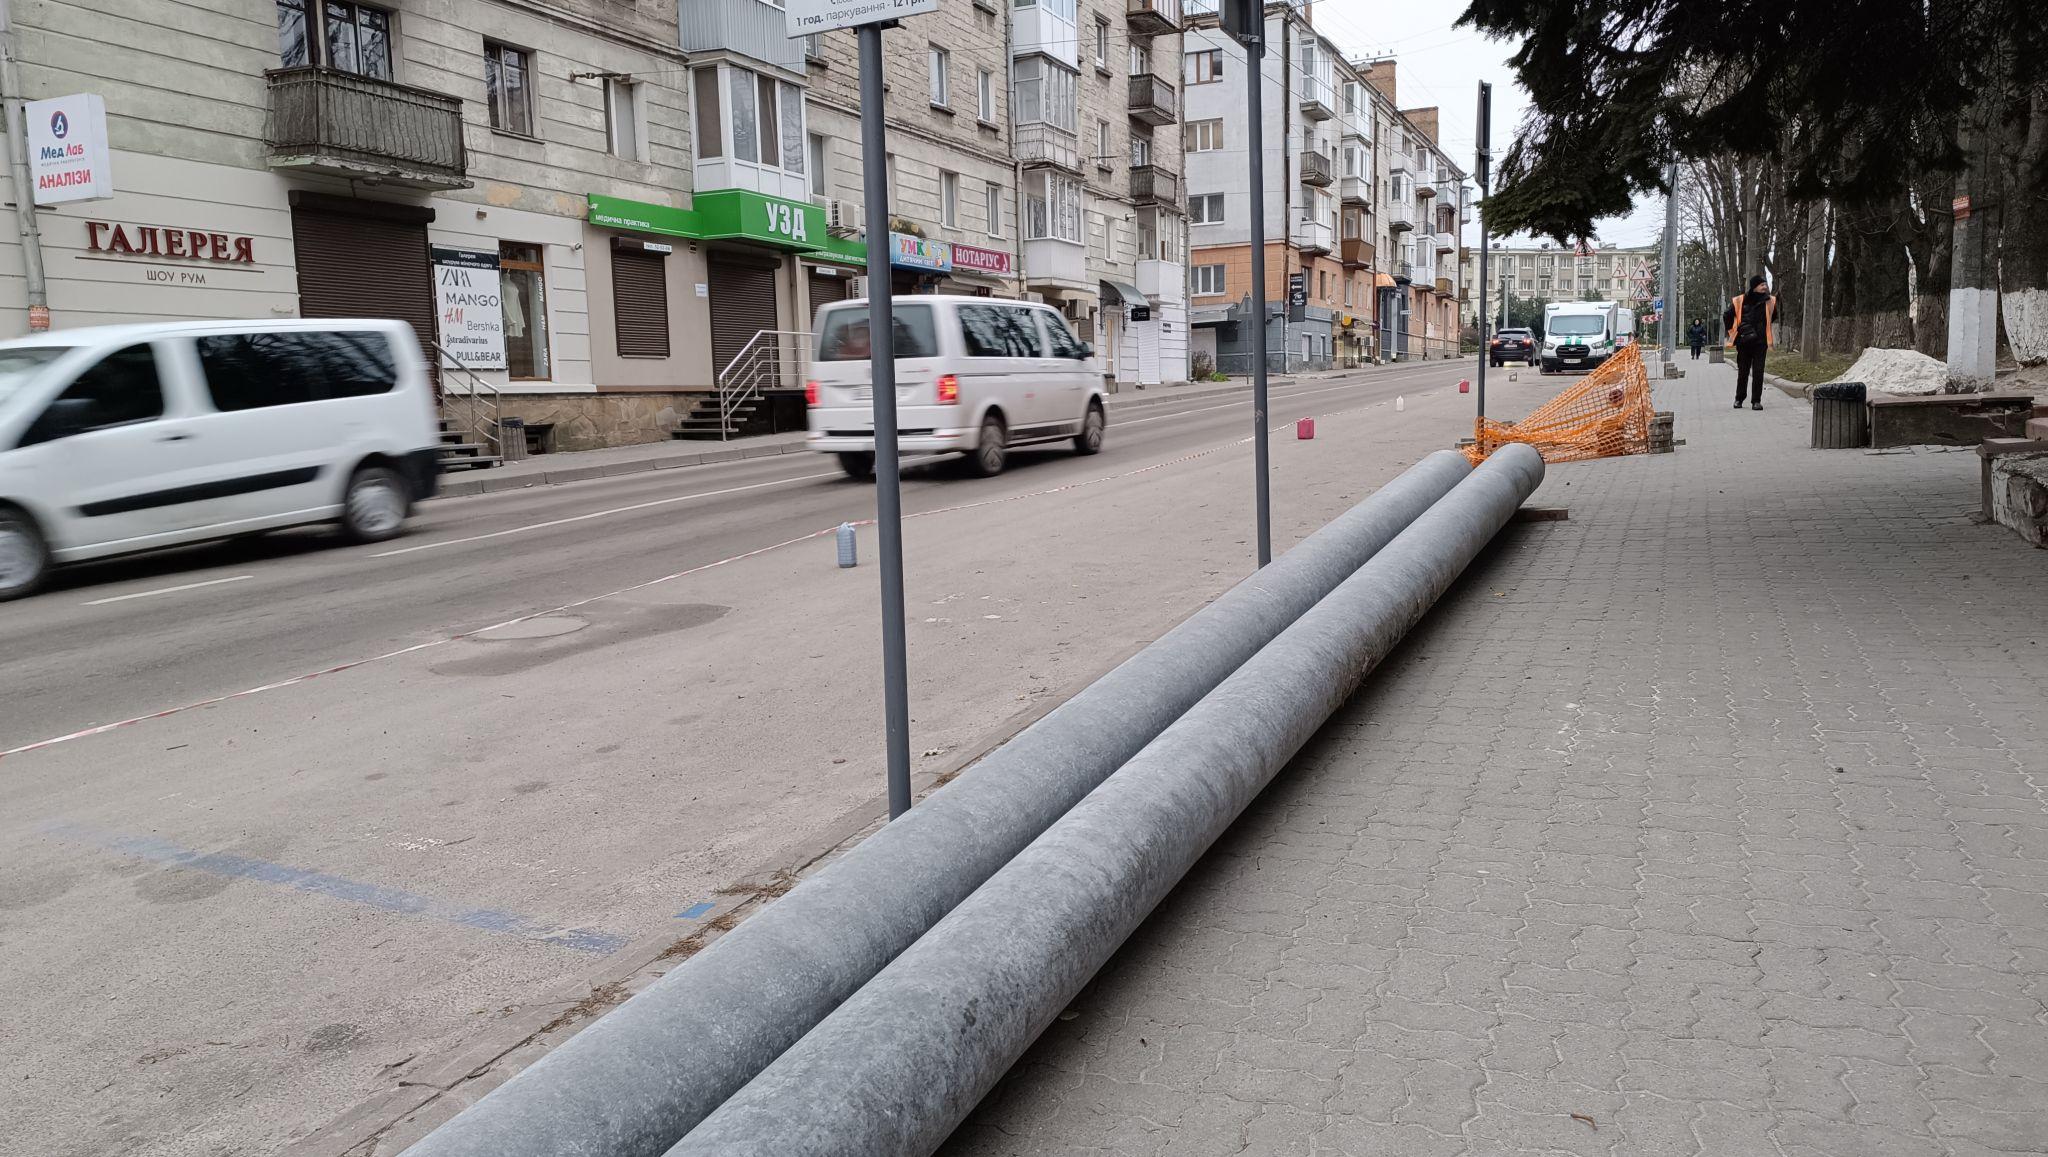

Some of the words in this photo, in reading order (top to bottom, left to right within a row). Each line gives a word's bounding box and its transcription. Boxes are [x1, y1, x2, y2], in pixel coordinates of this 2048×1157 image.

[796, 17, 801, 27] 1
[803, 15, 824, 26] год.
[826, 2, 886, 21] паркування
[893, 0, 904, 8] 12
[40, 146, 65, 160] Мед
[66, 143, 84, 157] Лаб
[39, 169, 91, 189] АНАЛІЗИ
[595, 214, 623, 224] медична
[623, 218, 650, 228] практика
[765, 201, 807, 242] УЗД
[85, 221, 256, 264] ГАЛЕРЕЯ
[900, 239, 931, 256] УМКА
[955, 247, 1000, 268] НОТАРІУС
[146, 270, 175, 283] ШОУ
[181, 273, 206, 285] РУМ
[441, 268, 471, 287] ZARA
[537, 276, 545, 303] MANGO
[446, 292, 499, 307] MANGO
[467, 320, 500, 332] Bershka
[456, 351, 501, 362] PULL&BEAR
